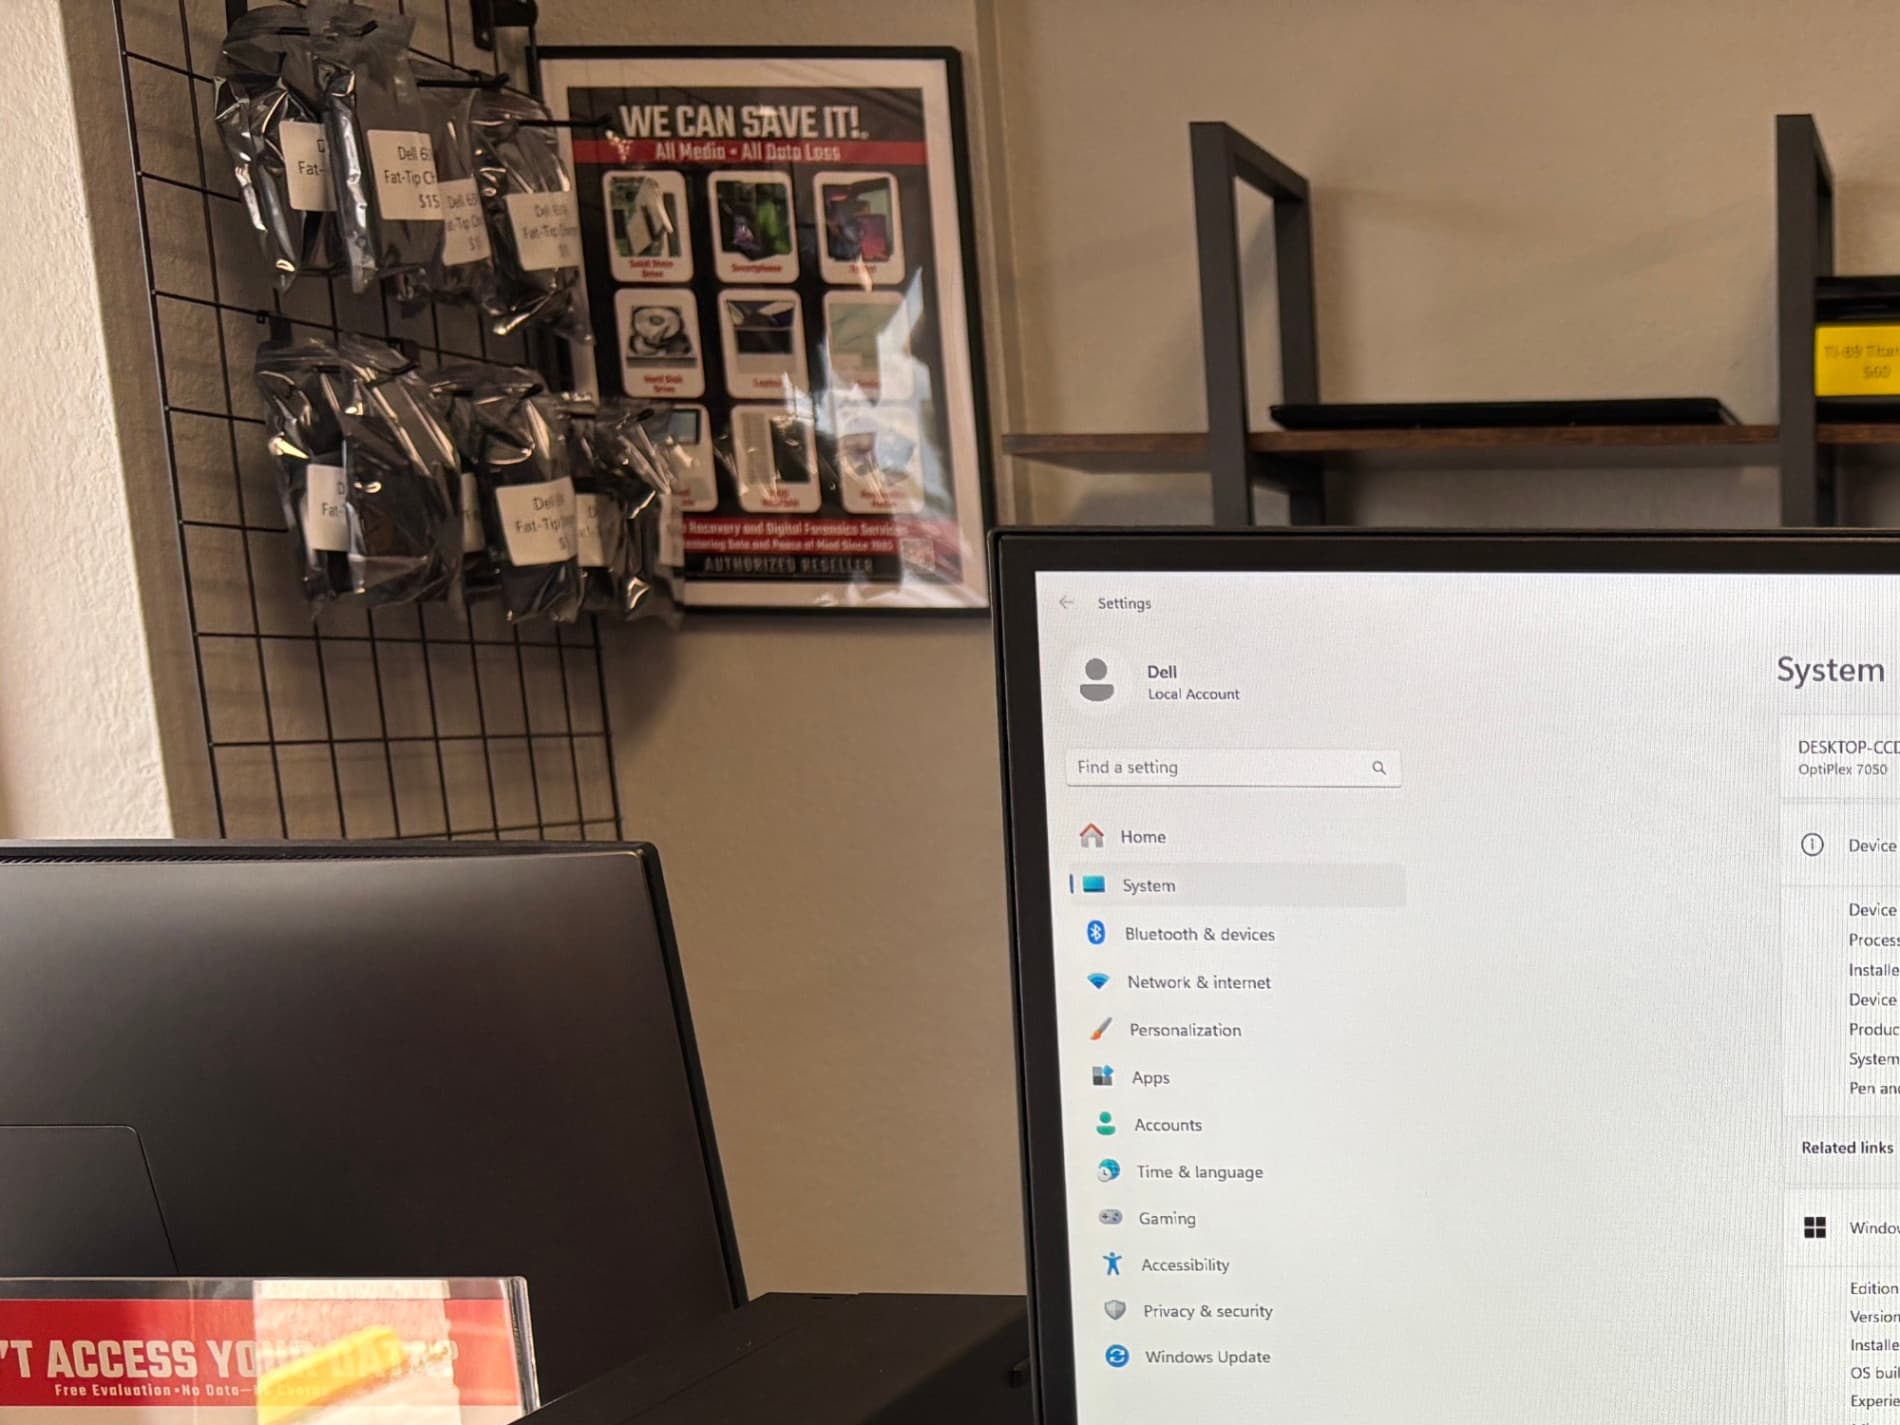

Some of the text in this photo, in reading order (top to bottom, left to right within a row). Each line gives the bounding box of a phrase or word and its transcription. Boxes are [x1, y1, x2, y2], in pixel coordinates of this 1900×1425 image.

[619, 104, 670, 139] WE
[675, 104, 735, 139] CAN
[742, 104, 817, 140] SAVE
[397, 145, 419, 160] Dell
[655, 142, 725, 160] All Media
[740, 142, 842, 162] All Data Loss
[384, 170, 421, 186] Fat-Tip
[418, 194, 441, 209] $15
[703, 556, 796, 575] AUTHORIZED
[1097, 597, 1152, 614] Settings
[1147, 664, 1178, 679] Dell
[1777, 655, 1885, 690] System
[1147, 688, 1240, 701] Local Account
[1077, 759, 1179, 778] Find a setting
[1797, 762, 1889, 778] OptiPlex 7050
[1120, 829, 1167, 844] Home
[1848, 837, 1898, 853] Device
[1122, 878, 1177, 896] System
[1848, 902, 1898, 917] Device
[1124, 926, 1276, 942] Bluetooth & devices
[1127, 974, 1272, 990] Network & internet
[1848, 992, 1898, 1007] Device
[1129, 1022, 1242, 1038] Personalization
[1131, 1070, 1171, 1088] Apps
[1134, 1117, 1203, 1132] Accounts
[1137, 1164, 1264, 1183] Time & language
[1138, 1210, 1197, 1229] Gaming
[1141, 1258, 1230, 1275] Accessibility
[1850, 1281, 1900, 1295] Edition
[1143, 1304, 1274, 1321] Privacy & security
[46, 1339, 198, 1380] ACCESS
[1144, 1349, 1272, 1367] Windows Update
[1850, 1366, 1871, 1380] OS
[54, 1383, 172, 1398] Free Evaluation
[181, 1384, 201, 1397] No
